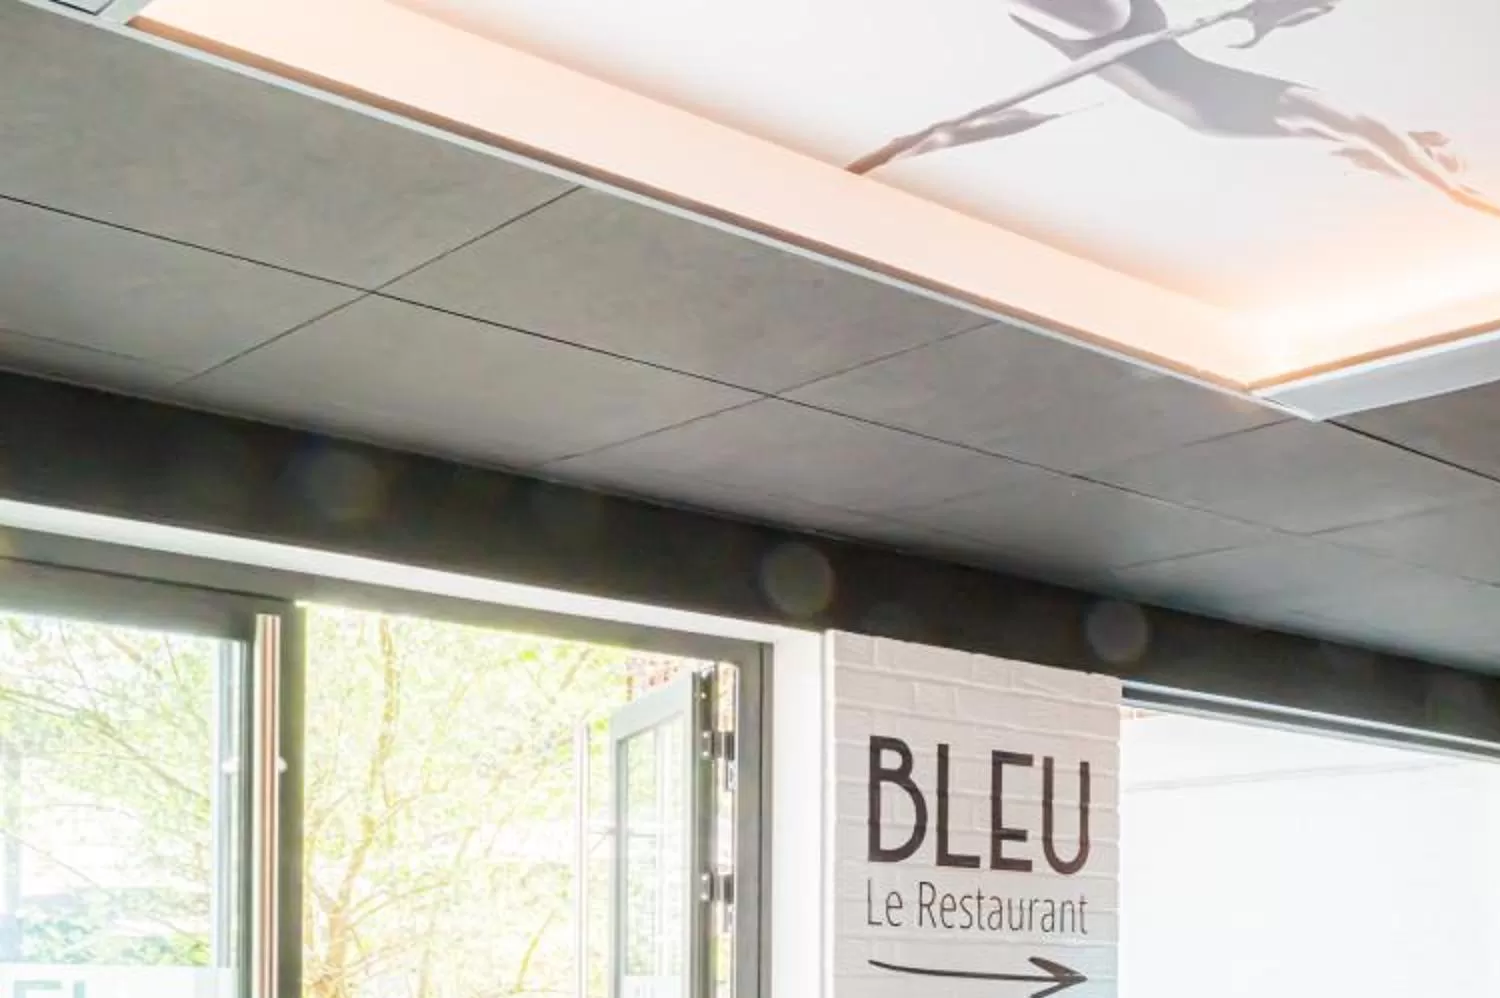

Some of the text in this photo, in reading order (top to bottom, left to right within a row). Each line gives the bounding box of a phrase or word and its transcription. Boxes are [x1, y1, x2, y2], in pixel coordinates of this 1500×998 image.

[868, 735, 1090, 875] BLEU
[867, 879, 1089, 935] Le Restaurant
